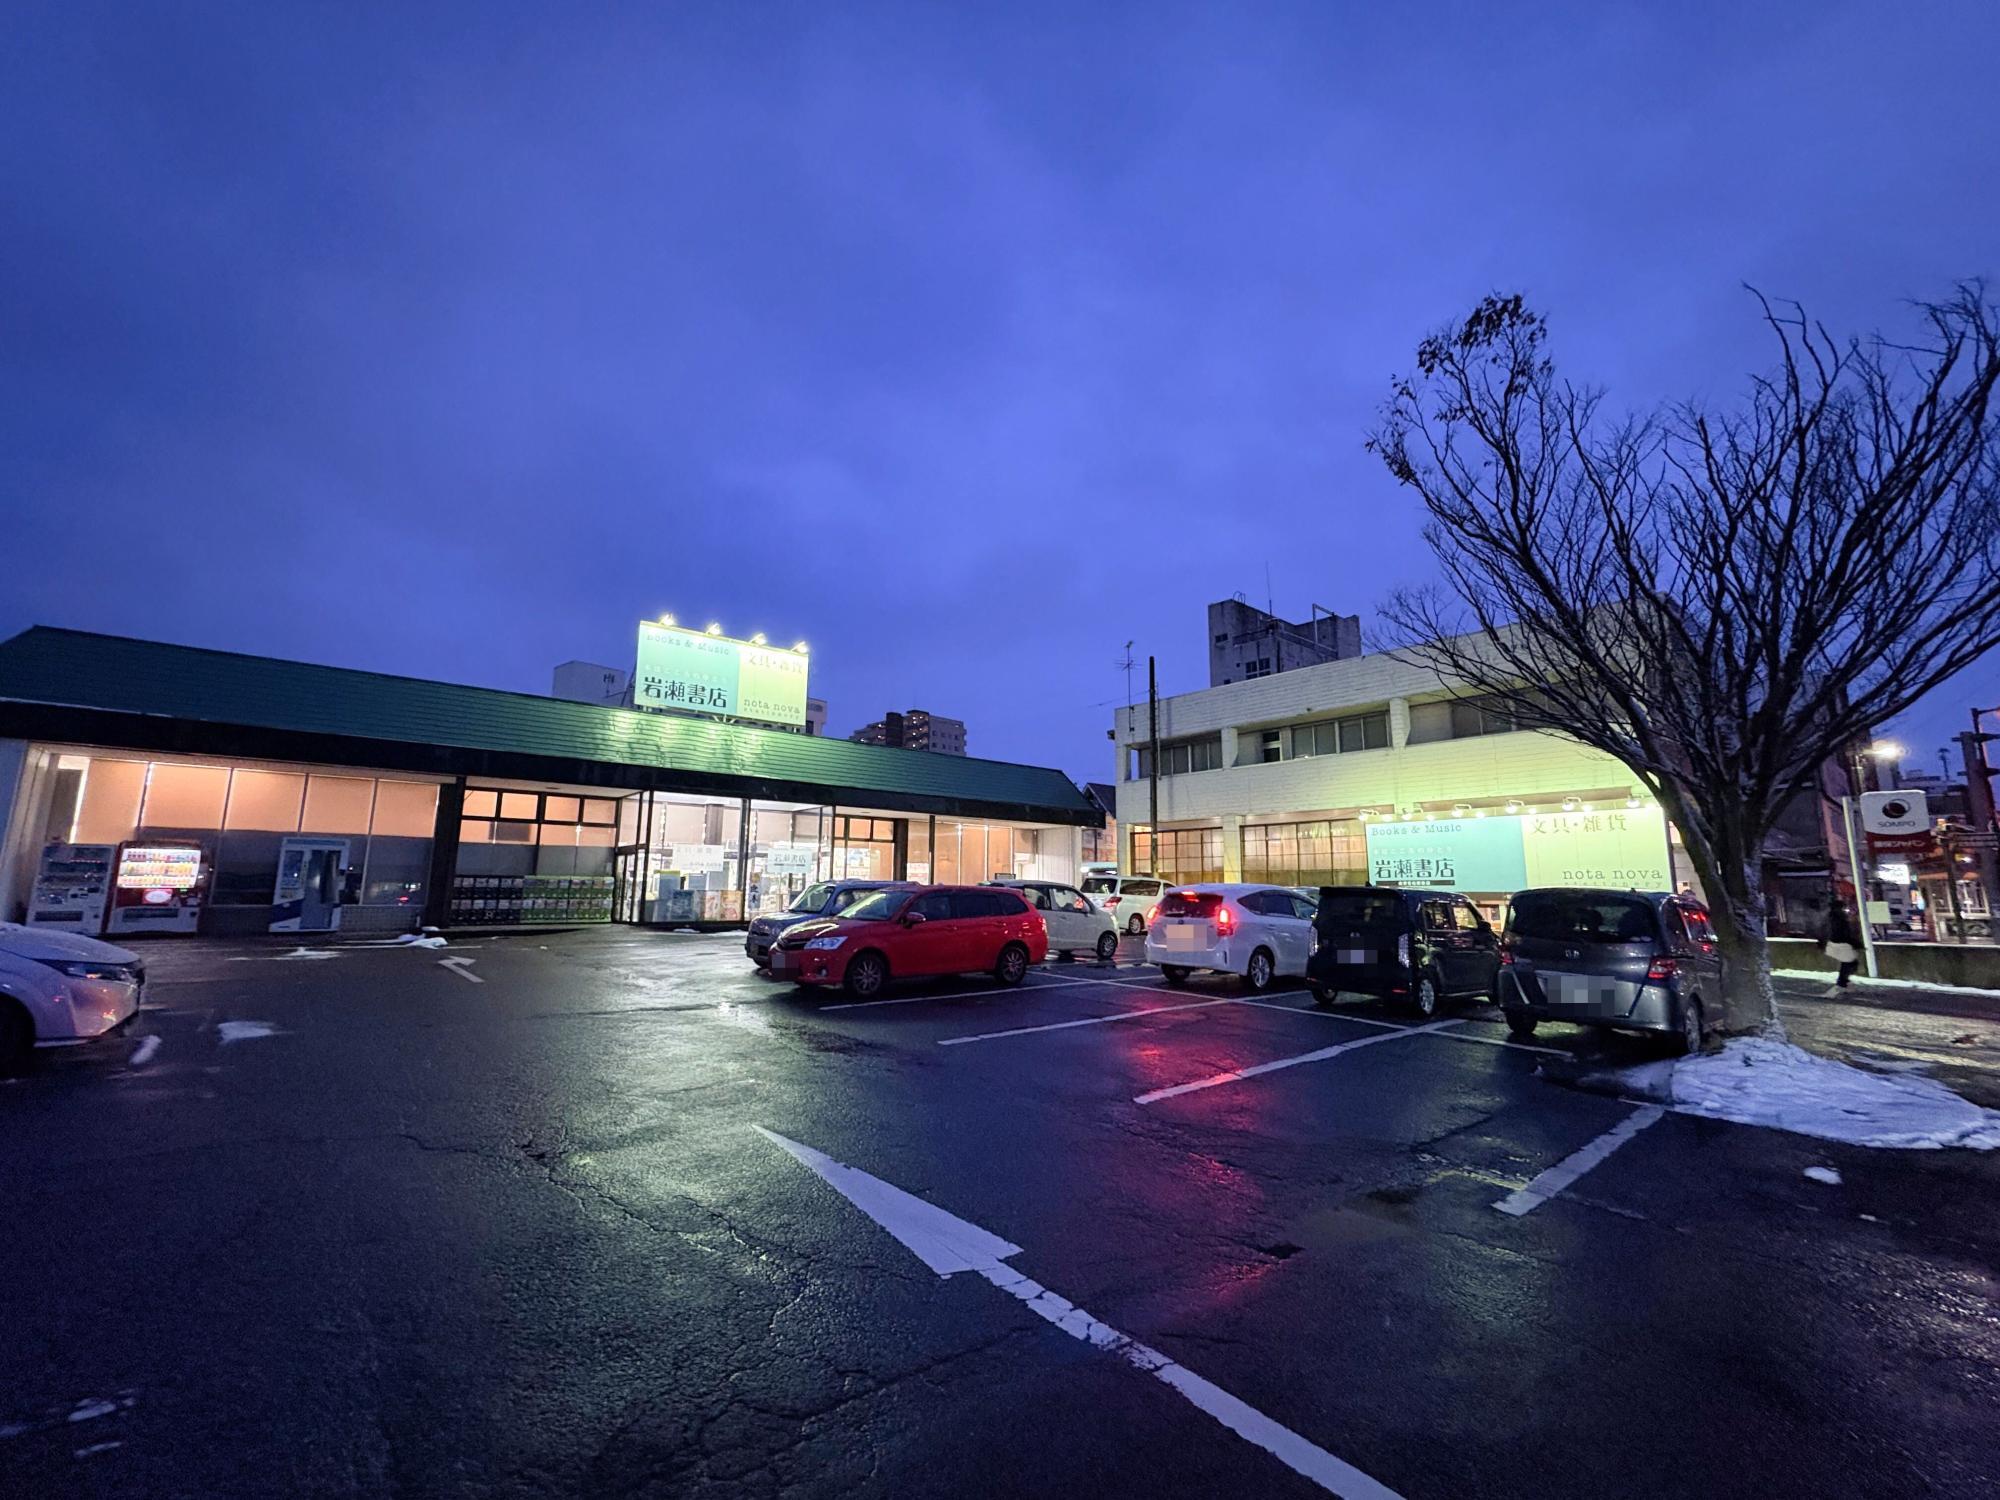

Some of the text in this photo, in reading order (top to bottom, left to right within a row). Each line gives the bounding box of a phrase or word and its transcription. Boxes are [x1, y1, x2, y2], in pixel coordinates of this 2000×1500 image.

[684, 639, 693, 648] &
[643, 676, 728, 708] 岩瀬書店
[743, 698, 801, 714] nota nova
[1371, 823, 1462, 836] Books & Music
[1531, 814, 1628, 834] 文具・雑貨
[1877, 820, 1916, 828] SOMPO
[1375, 858, 1455, 879] 岩瀬書店
[1562, 867, 1663, 880] nota nova
